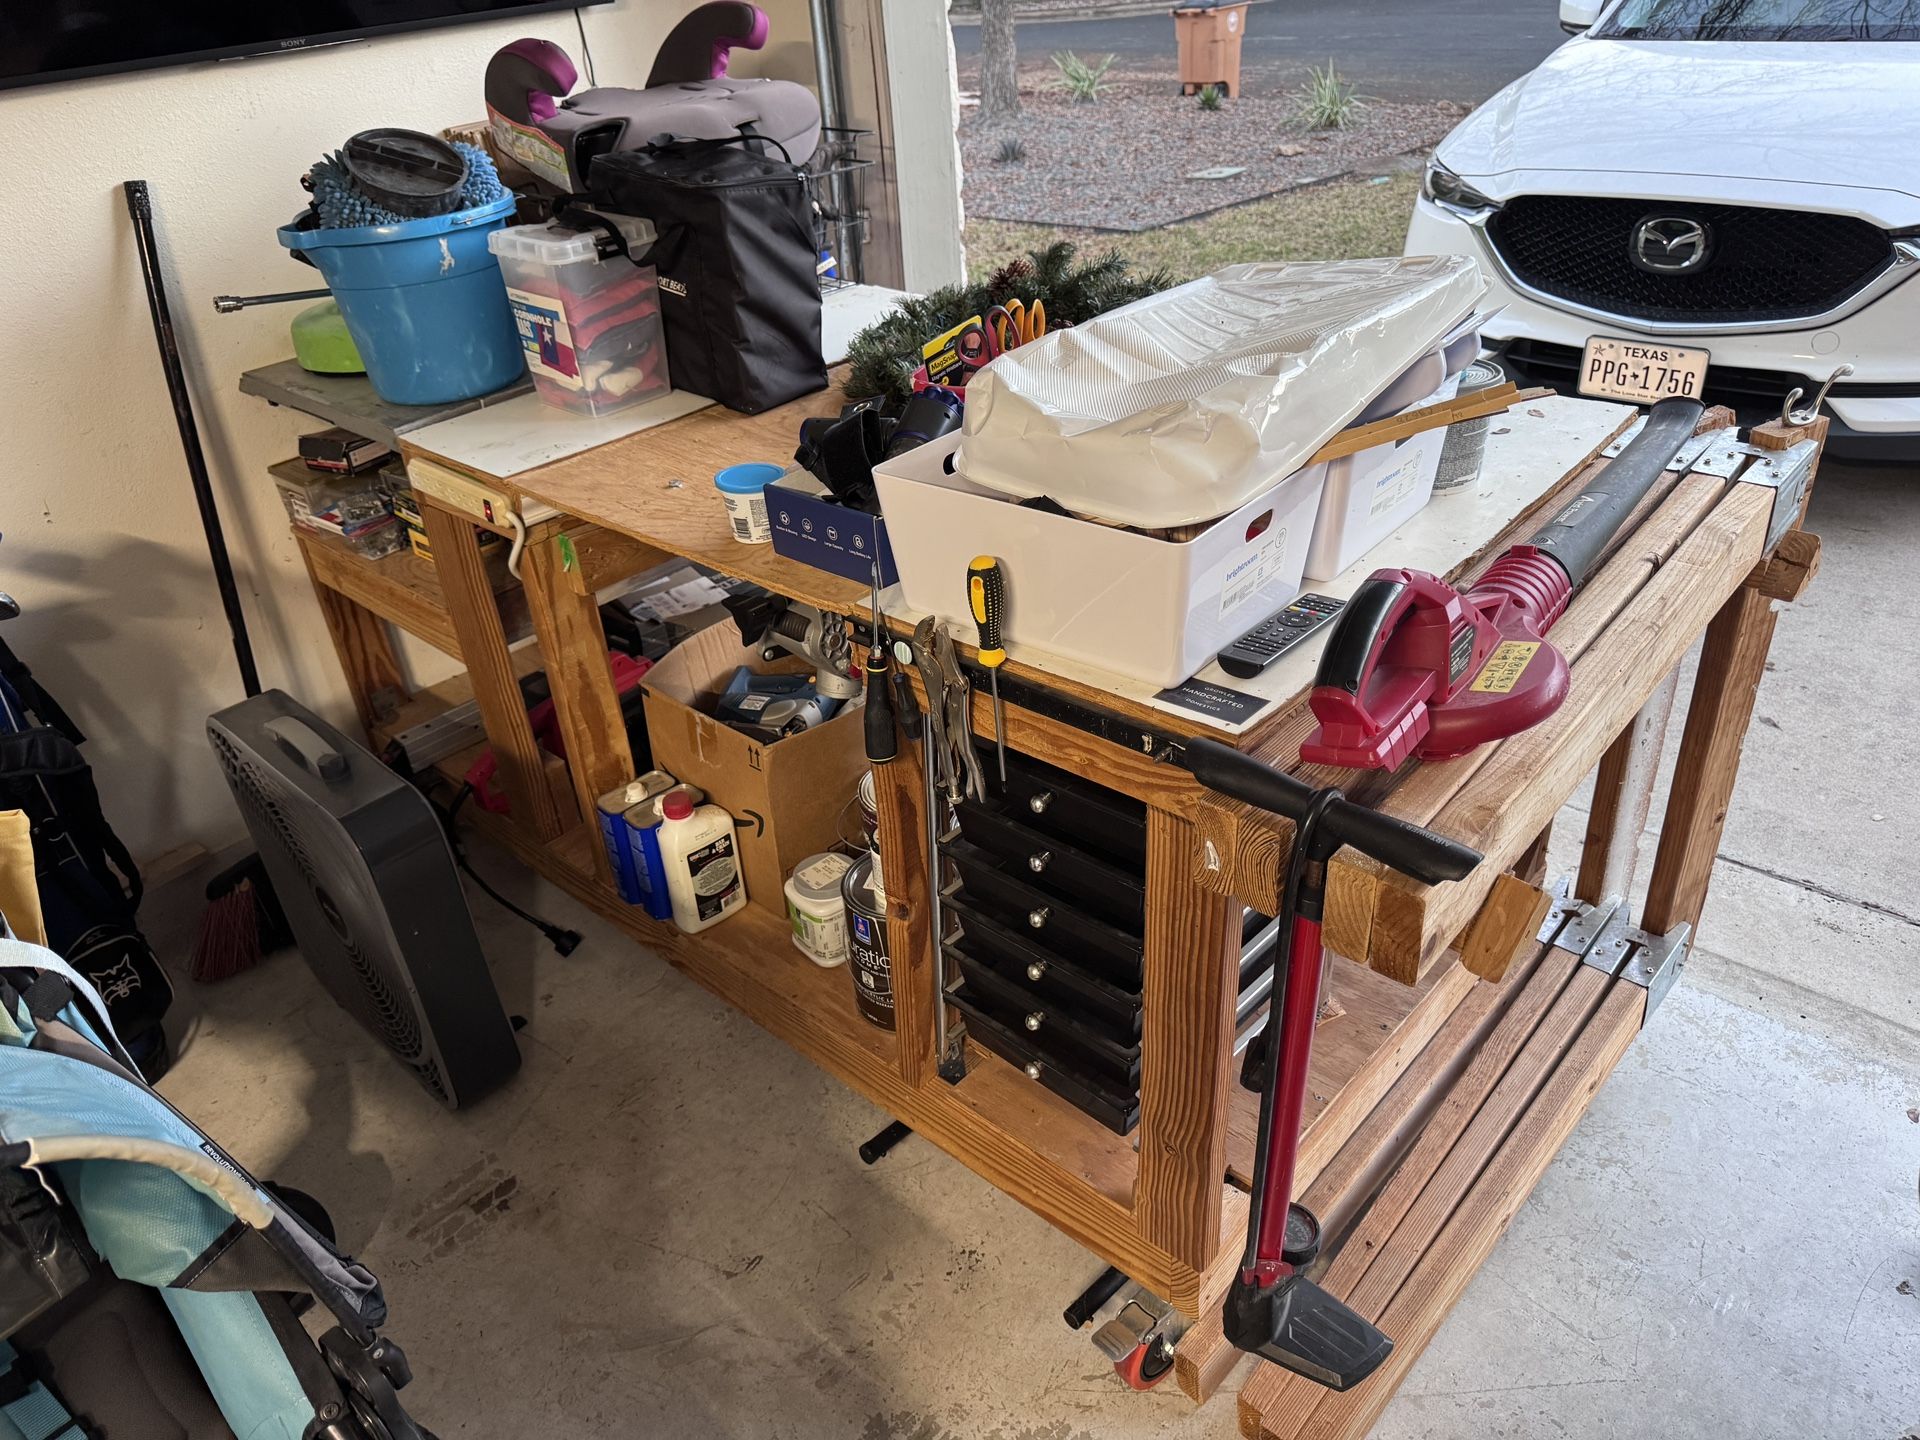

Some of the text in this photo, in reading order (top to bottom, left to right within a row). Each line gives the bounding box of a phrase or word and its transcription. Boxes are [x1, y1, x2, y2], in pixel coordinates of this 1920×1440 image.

[281, 39, 306, 48] SONY
[514, 308, 553, 327] CORNHOLE
[1624, 346, 1668, 362] TEXAS
[1588, 358, 1695, 396] PPG 1756
[1226, 553, 1258, 581] brightroom
[1182, 687, 1244, 709] HANDCRAFTED
[1204, 686, 1236, 698] GROWLER
[1185, 697, 1221, 711] DOMESTICS
[852, 941, 891, 969] uratio
